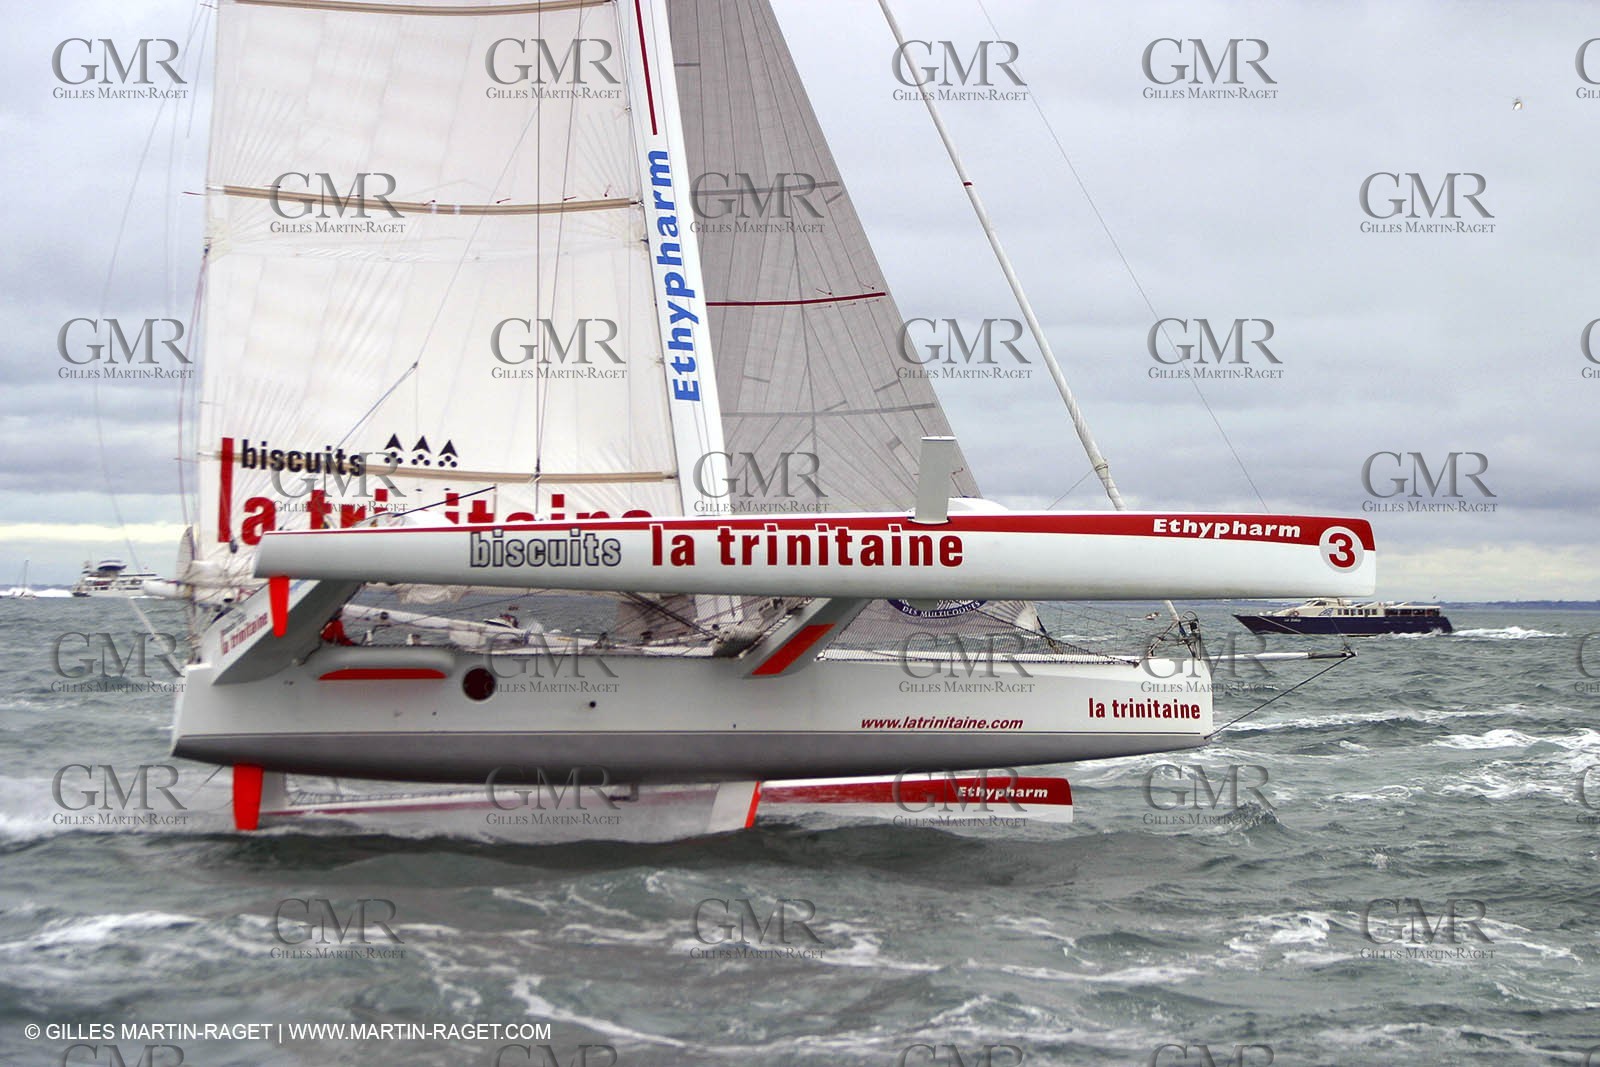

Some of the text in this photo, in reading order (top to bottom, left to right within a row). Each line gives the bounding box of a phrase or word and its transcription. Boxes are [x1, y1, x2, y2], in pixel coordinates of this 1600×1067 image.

[648, 150, 701, 401] Ethypharm
[241, 439, 366, 477] biscuits
[218, 437, 276, 546] la
[470, 523, 963, 568] biscuits la trinitaine
[1153, 518, 1300, 539] Ethypharm
[1328, 532, 1356, 568] 3
[861, 716, 1024, 730] www.latrinitaine.com
[1089, 698, 1201, 719] la trinitaine
[958, 786, 1048, 801] Ethypharm
